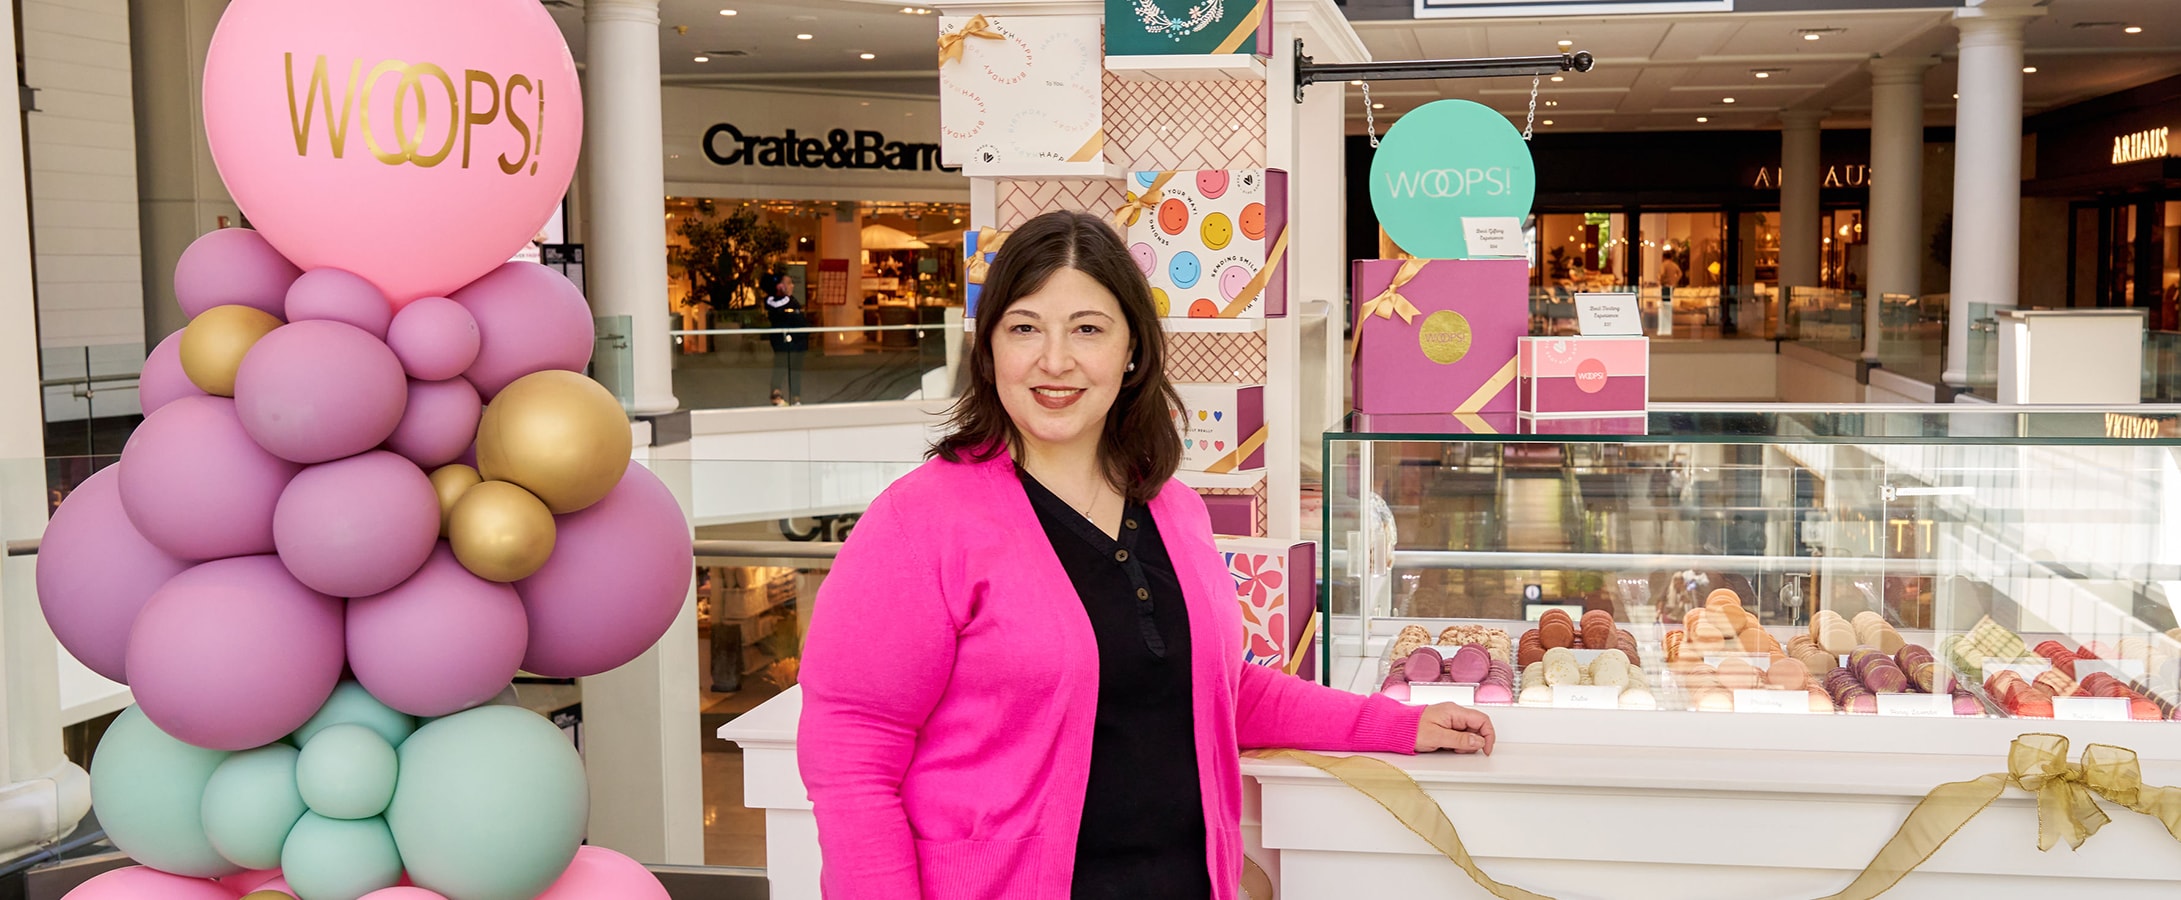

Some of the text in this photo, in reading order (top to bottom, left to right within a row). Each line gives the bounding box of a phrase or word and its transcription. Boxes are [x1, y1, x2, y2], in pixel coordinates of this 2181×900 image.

[983, 37, 1033, 85] HAPPY BIRTHDAY
[284, 51, 545, 177] WOOPS!
[961, 89, 987, 114] HAPPY
[2111, 126, 2169, 165] ARHAUS
[1167, 188, 1187, 197] YOUR
[1384, 166, 1512, 199] WOOPS!
[1210, 255, 1237, 278] SENDING
[1577, 371, 1604, 381] WOOPS!
